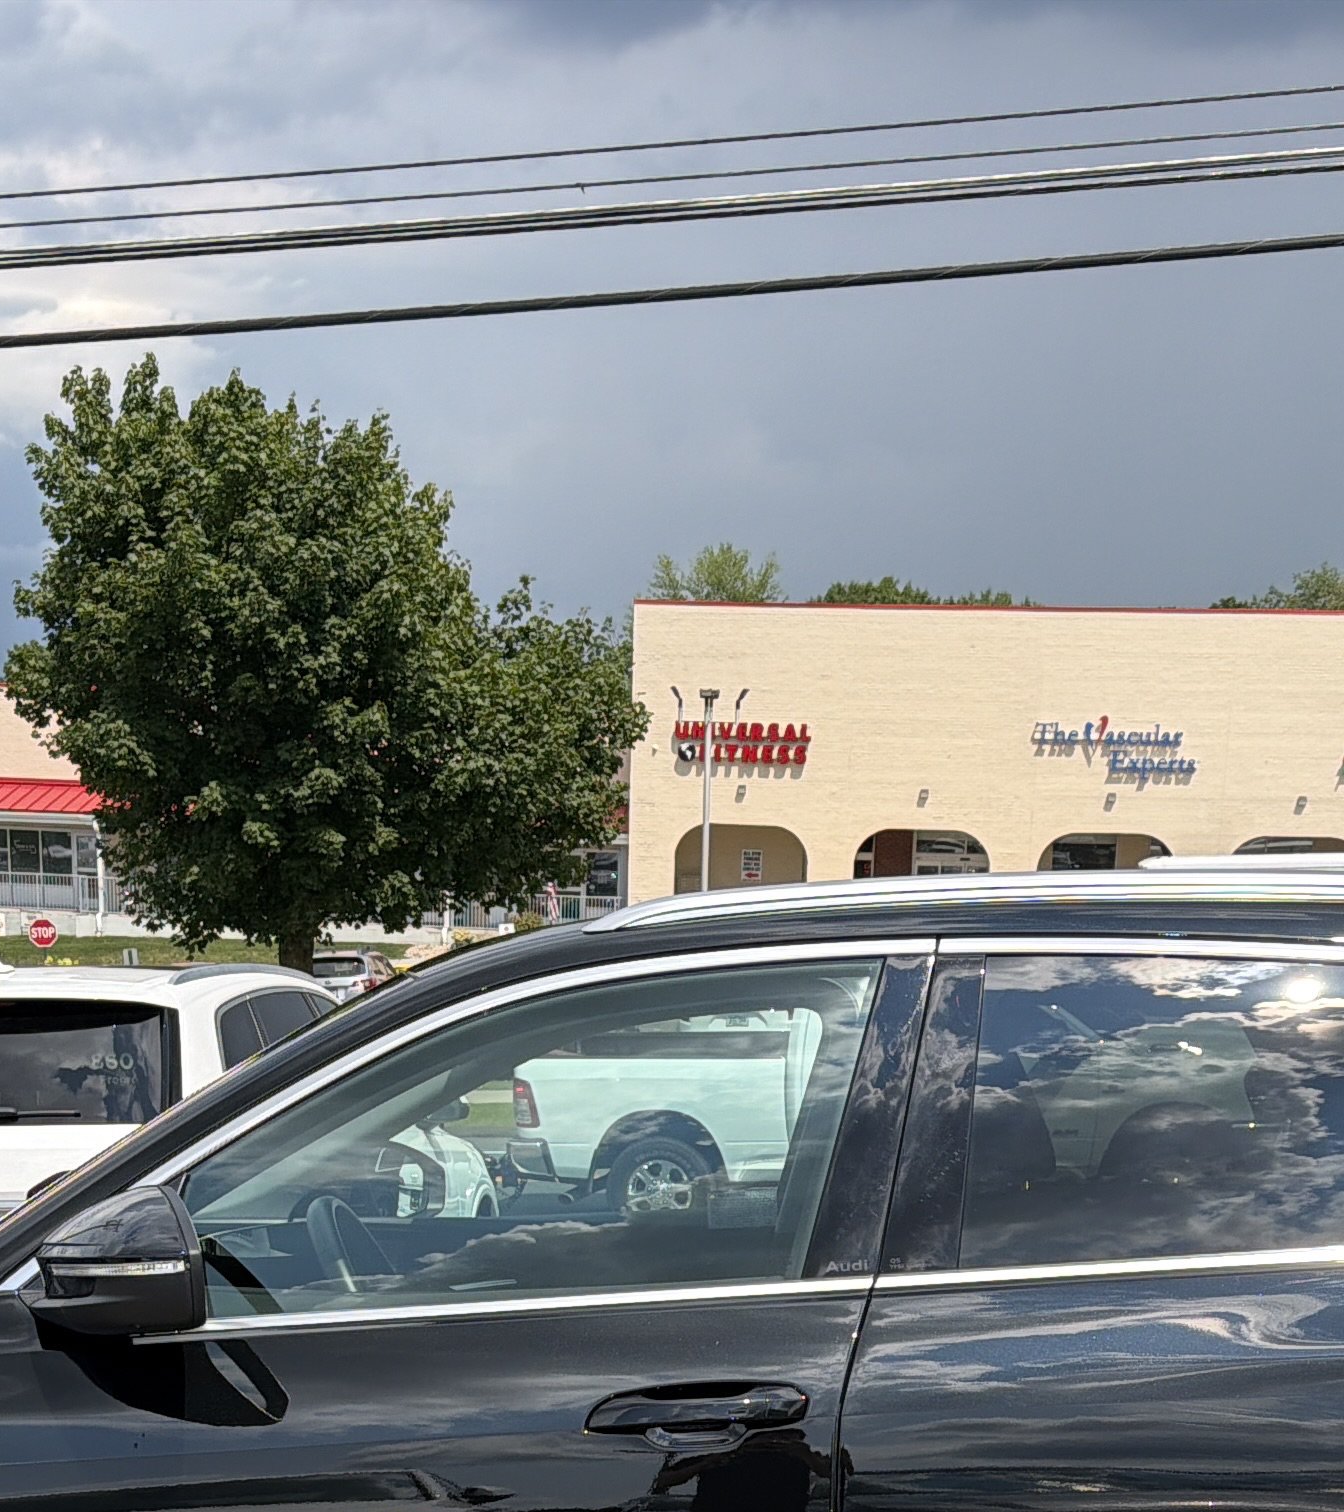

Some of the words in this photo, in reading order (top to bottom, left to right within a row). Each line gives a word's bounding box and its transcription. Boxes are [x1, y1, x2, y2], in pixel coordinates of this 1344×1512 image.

[674, 720, 812, 743] UNIVERSAL
[1033, 722, 1079, 745] The
[1084, 715, 1184, 747] Vascular
[1109, 750, 1198, 779] Experts
[31, 925, 55, 940] STOP
[825, 1259, 869, 1273] Audi
